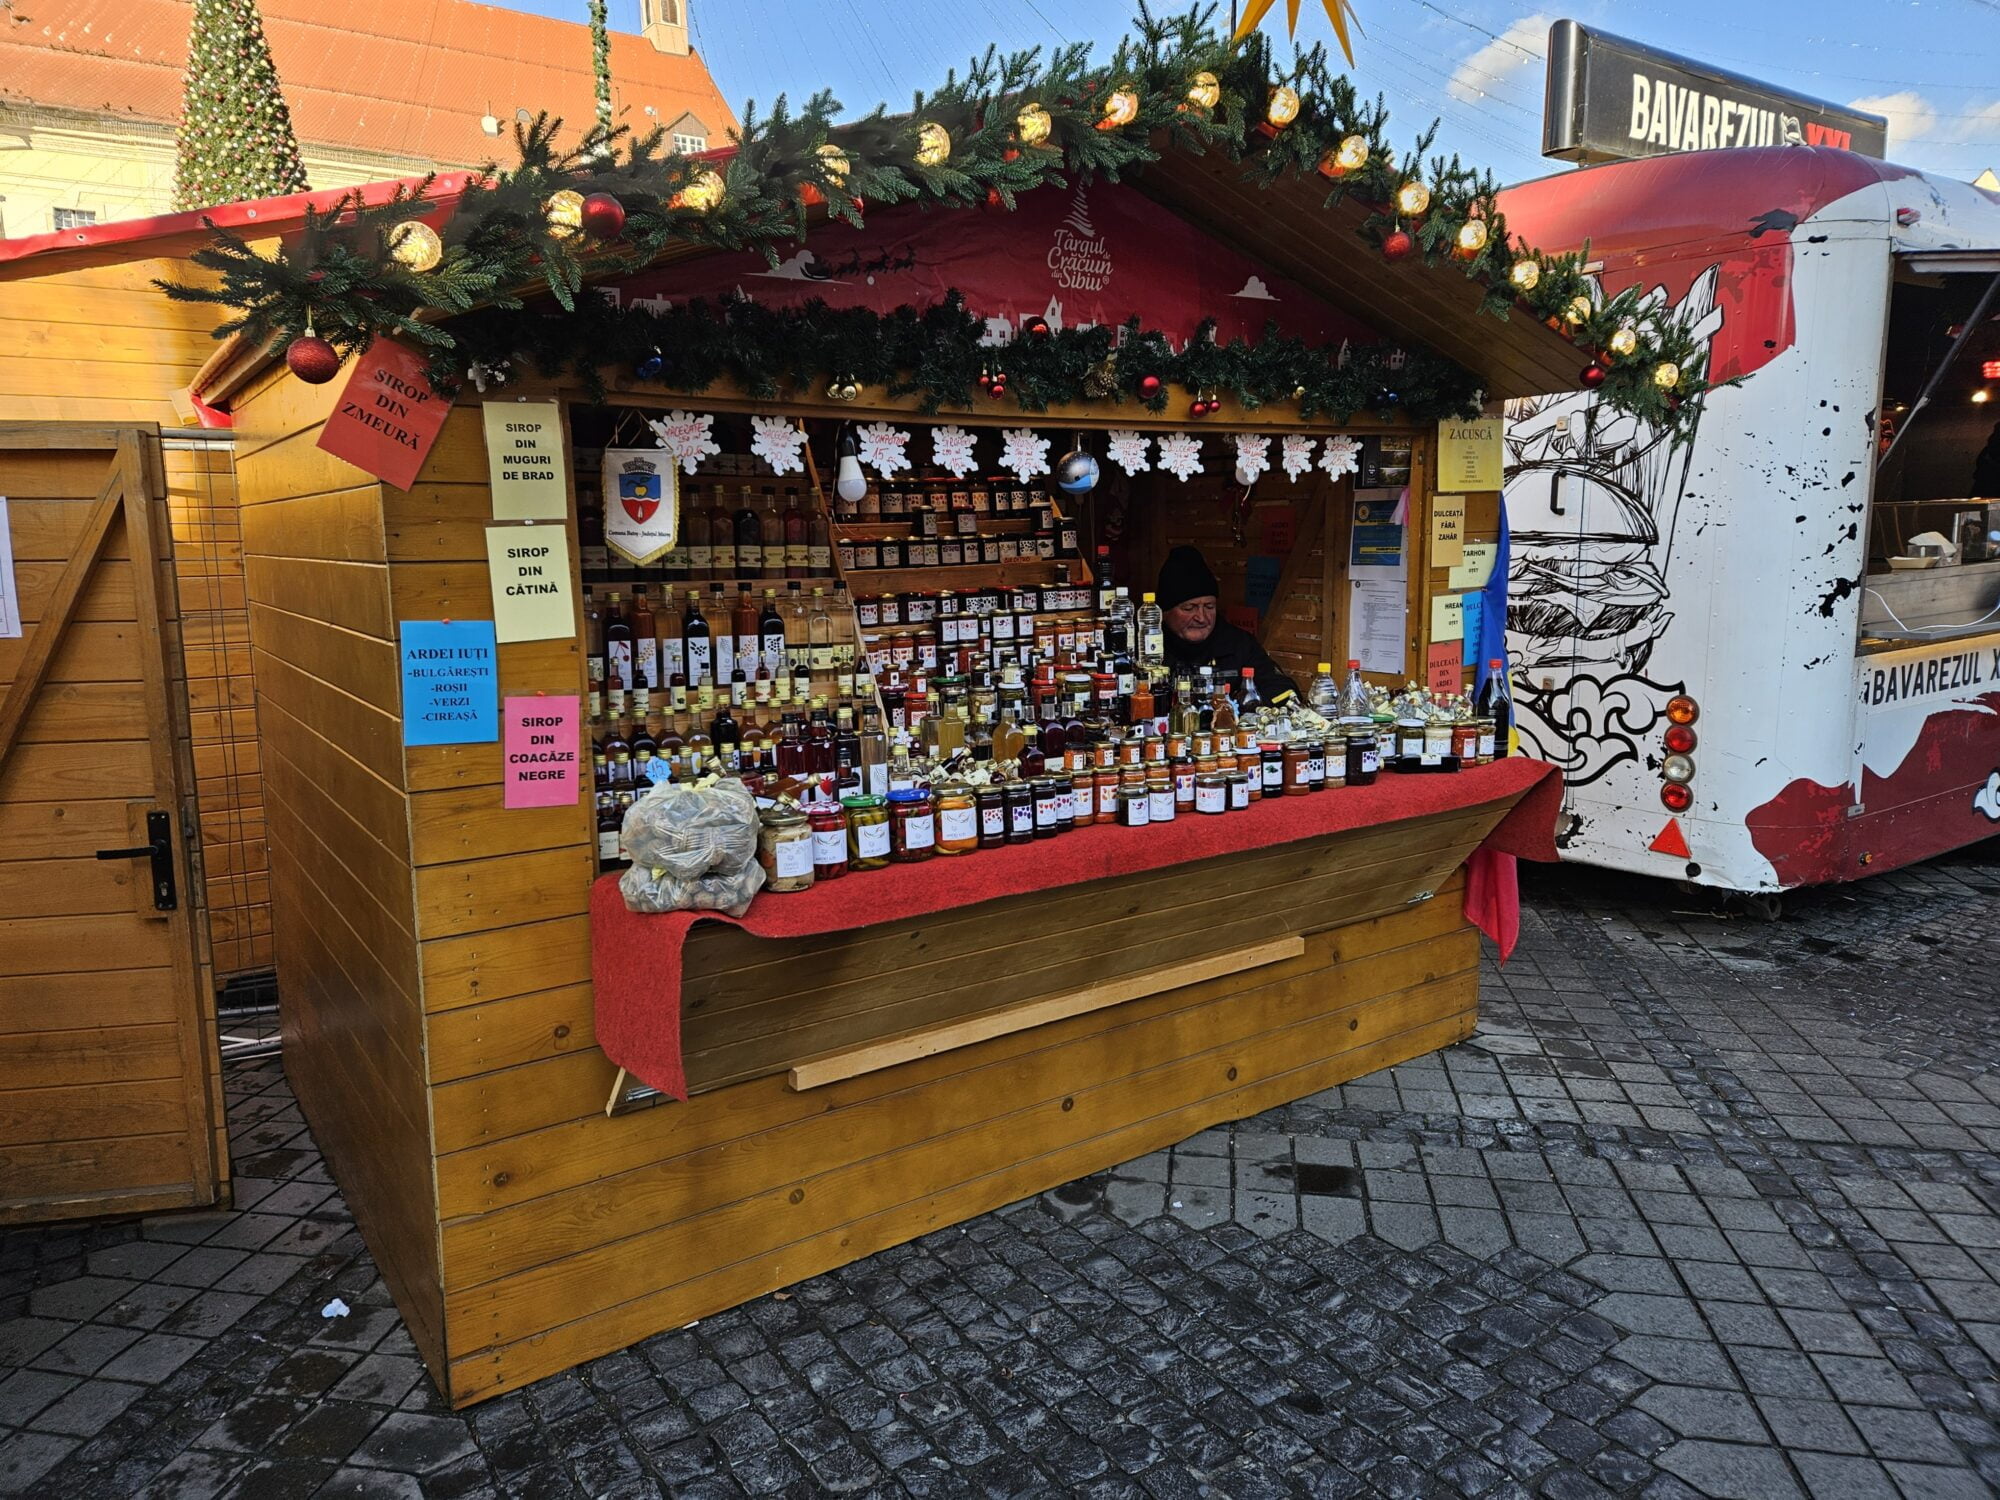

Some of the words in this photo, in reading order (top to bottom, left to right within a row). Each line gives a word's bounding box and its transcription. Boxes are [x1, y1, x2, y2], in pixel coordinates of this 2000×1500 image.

[1054, 229, 1106, 258] Târgul
[1047, 246, 1113, 275] Crăciun
[1058, 265, 1103, 291] Sibiu
[374, 368, 429, 404] SIROP
[375, 394, 409, 419] DIN
[341, 402, 421, 450] ZMEURĂ
[505, 423, 542, 433] SIROP
[1449, 426, 1493, 441] ZACUSCĂ
[515, 439, 536, 448] DIN
[503, 455, 551, 465] MUGURI
[872, 448, 888, 460] 15
[502, 471, 519, 481] DE
[522, 471, 554, 481] BRAD
[1433, 509, 1464, 519] DULCEAȚĂ
[1441, 521, 1456, 529] FĂRĂ
[1438, 533, 1458, 541] ZAHĂR
[507, 547, 549, 559] SIROP
[518, 566, 543, 576] DIN
[505, 581, 559, 596] CĂTINĂ
[407, 648, 454, 660] ARDEI
[458, 647, 489, 661] IUȚI
[1429, 657, 1460, 669] DULCEAȚĂ
[1439, 669, 1450, 677] DIN
[1872, 652, 1981, 706] BAVAREZUL
[1435, 680, 1453, 688] ARDEI
[521, 716, 563, 727] SIROP
[530, 735, 555, 745] DIN
[509, 751, 575, 764] COACĂZE
[518, 769, 566, 782] NEGRE
